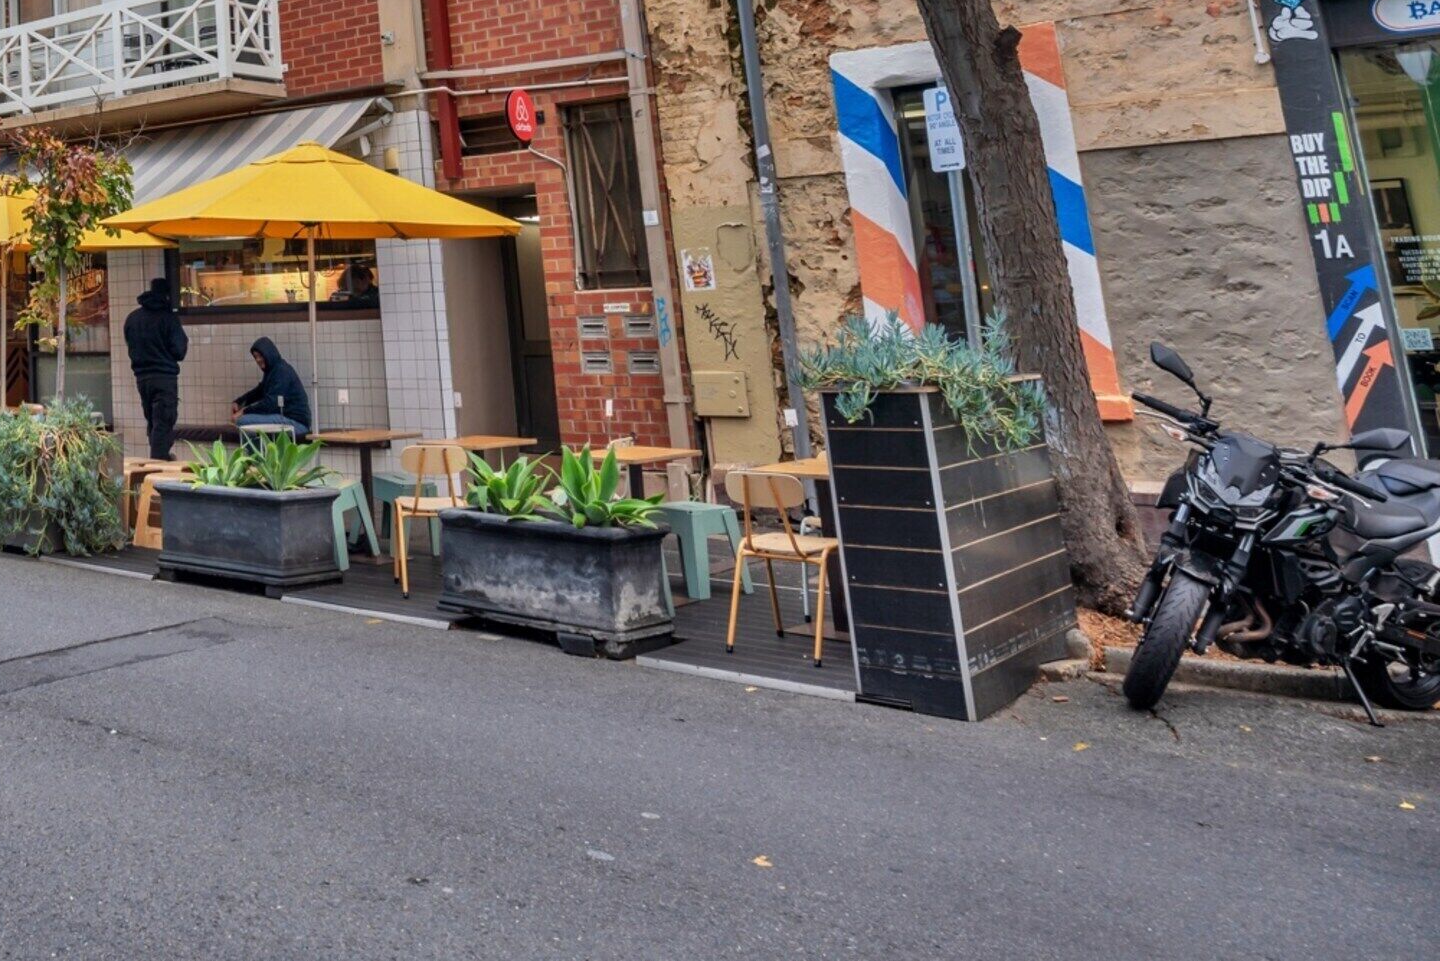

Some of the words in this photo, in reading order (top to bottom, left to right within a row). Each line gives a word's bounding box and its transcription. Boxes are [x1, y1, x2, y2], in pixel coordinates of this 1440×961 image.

[935, 91, 947, 111] P
[1290, 132, 1324, 154] BUY
[1295, 155, 1330, 175] THE
[1301, 177, 1332, 198] DIP
[1341, 289, 1358, 310] SCAN
[1355, 332, 1366, 343] TO
[1360, 367, 1375, 387] BOOK
